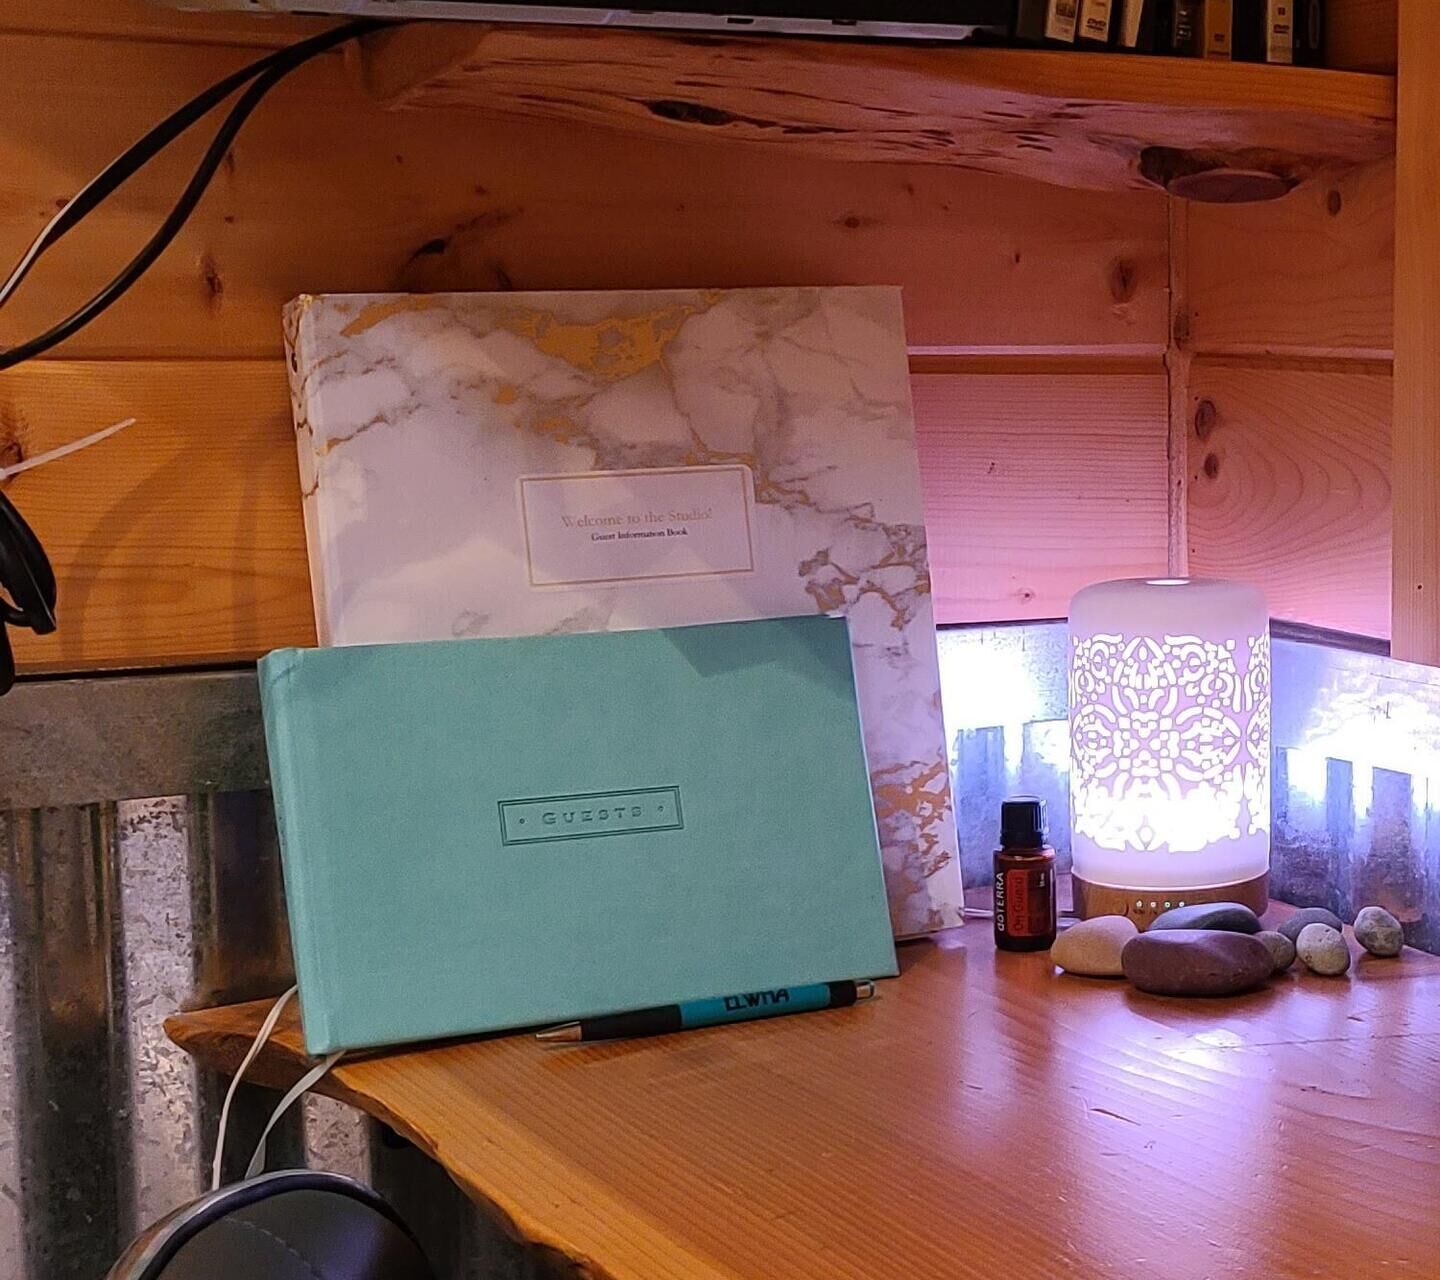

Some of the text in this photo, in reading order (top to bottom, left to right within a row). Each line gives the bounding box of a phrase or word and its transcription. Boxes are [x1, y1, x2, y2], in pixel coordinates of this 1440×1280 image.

[561, 506, 713, 528] Welcome to the Studio!
[591, 527, 689, 542] Guest Information Book
[541, 806, 643, 825] GUESTS
